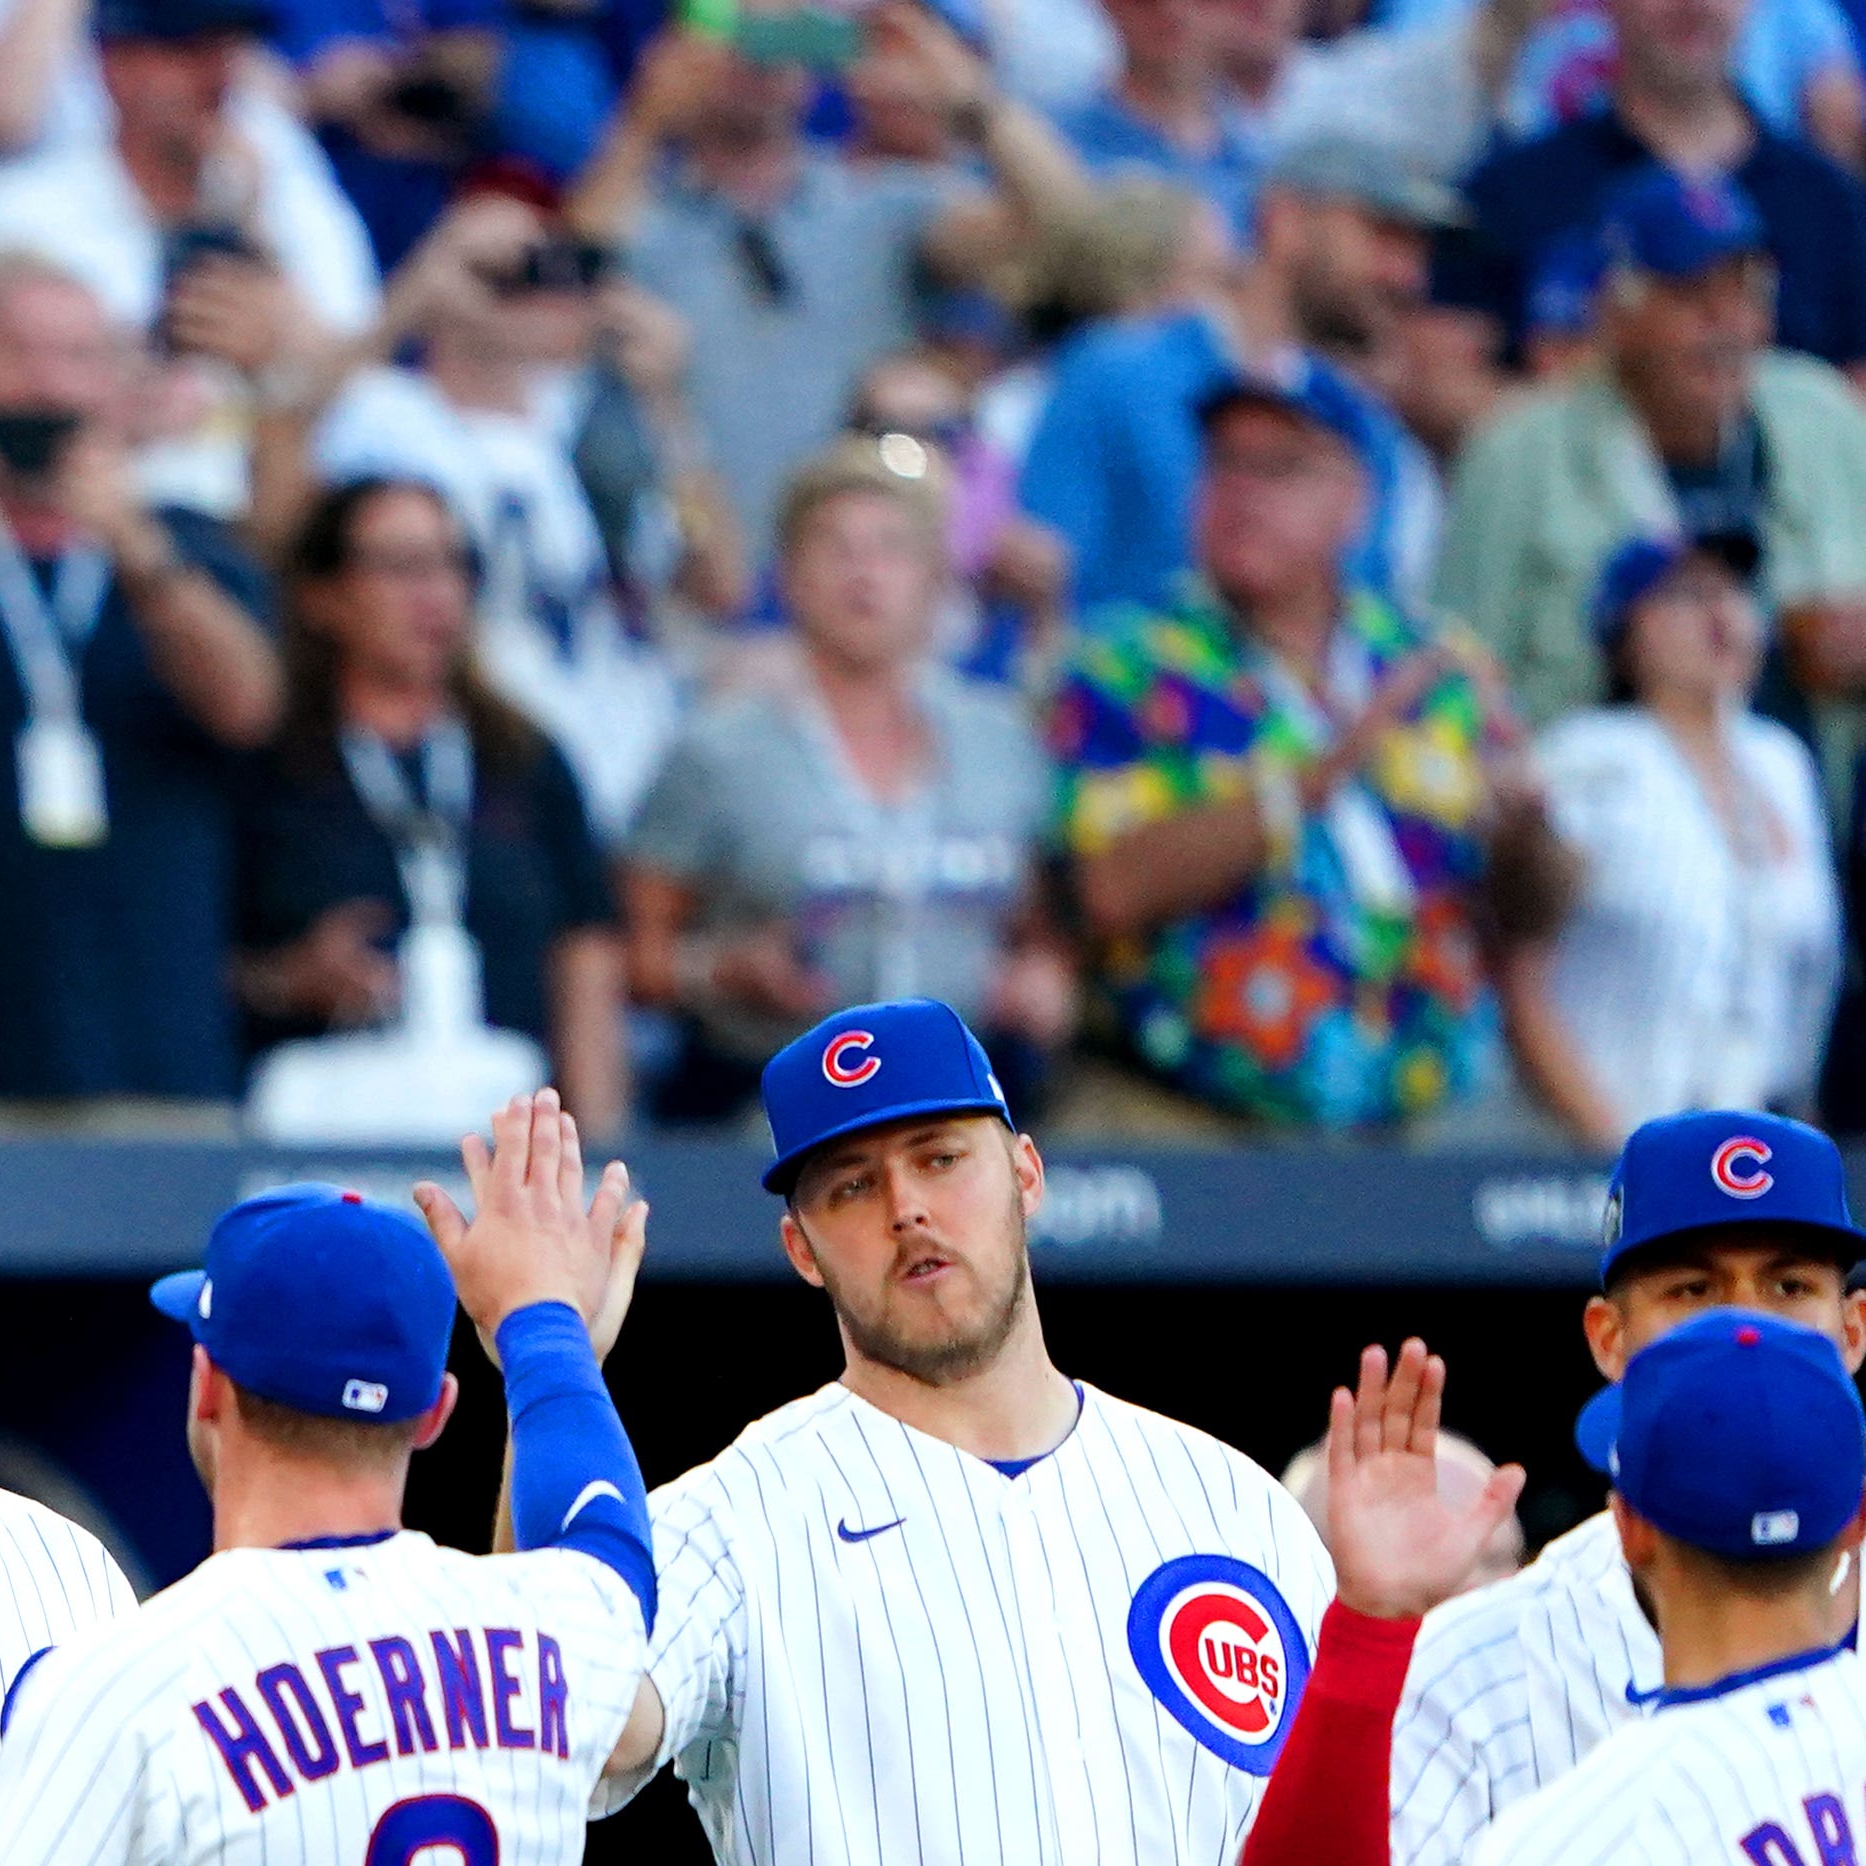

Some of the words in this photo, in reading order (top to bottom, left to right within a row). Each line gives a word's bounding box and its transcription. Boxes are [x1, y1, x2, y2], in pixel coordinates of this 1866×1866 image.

[820, 1030, 881, 1088] C
[1710, 1135, 1774, 1200] C
[191, 1628, 571, 1814] HOERNER
